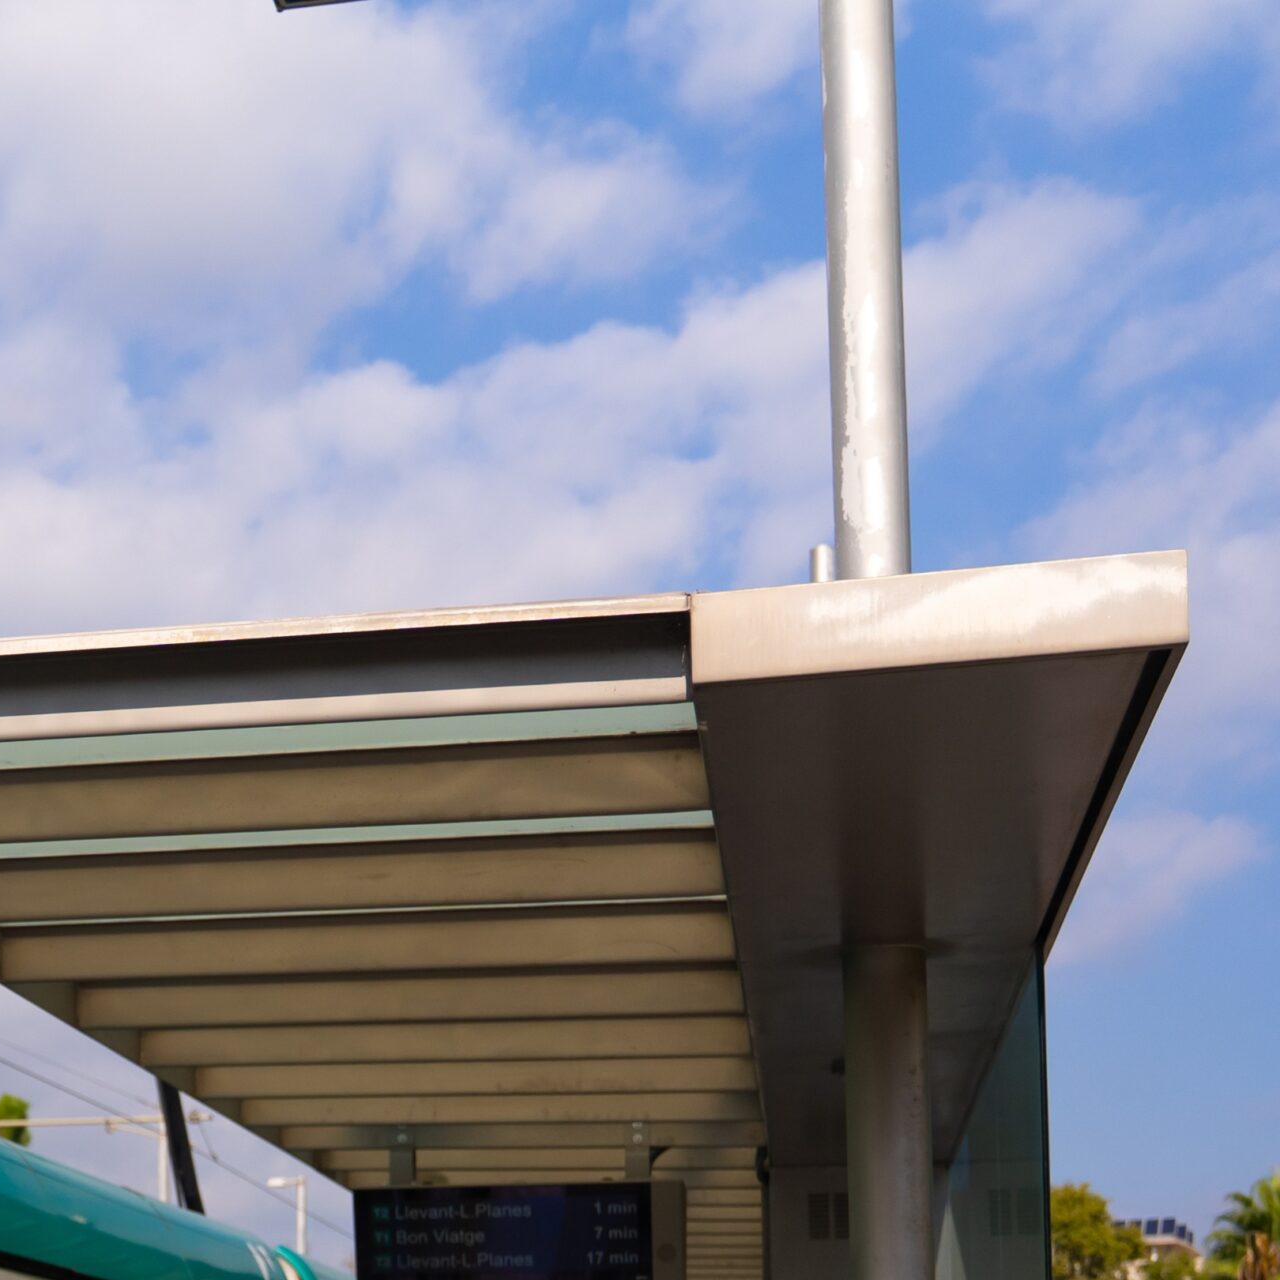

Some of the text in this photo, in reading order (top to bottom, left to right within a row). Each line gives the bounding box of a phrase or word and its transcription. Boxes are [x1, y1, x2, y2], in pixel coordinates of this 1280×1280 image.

[594, 1202, 602, 1215] 1
[607, 1201, 638, 1215] min
[395, 1230, 428, 1245] Bon
[432, 1229, 486, 1247] Viatge
[594, 1226, 603, 1240] 7
[608, 1226, 638, 1240] min
[586, 1251, 604, 1265] 17
[609, 1251, 639, 1264] min
